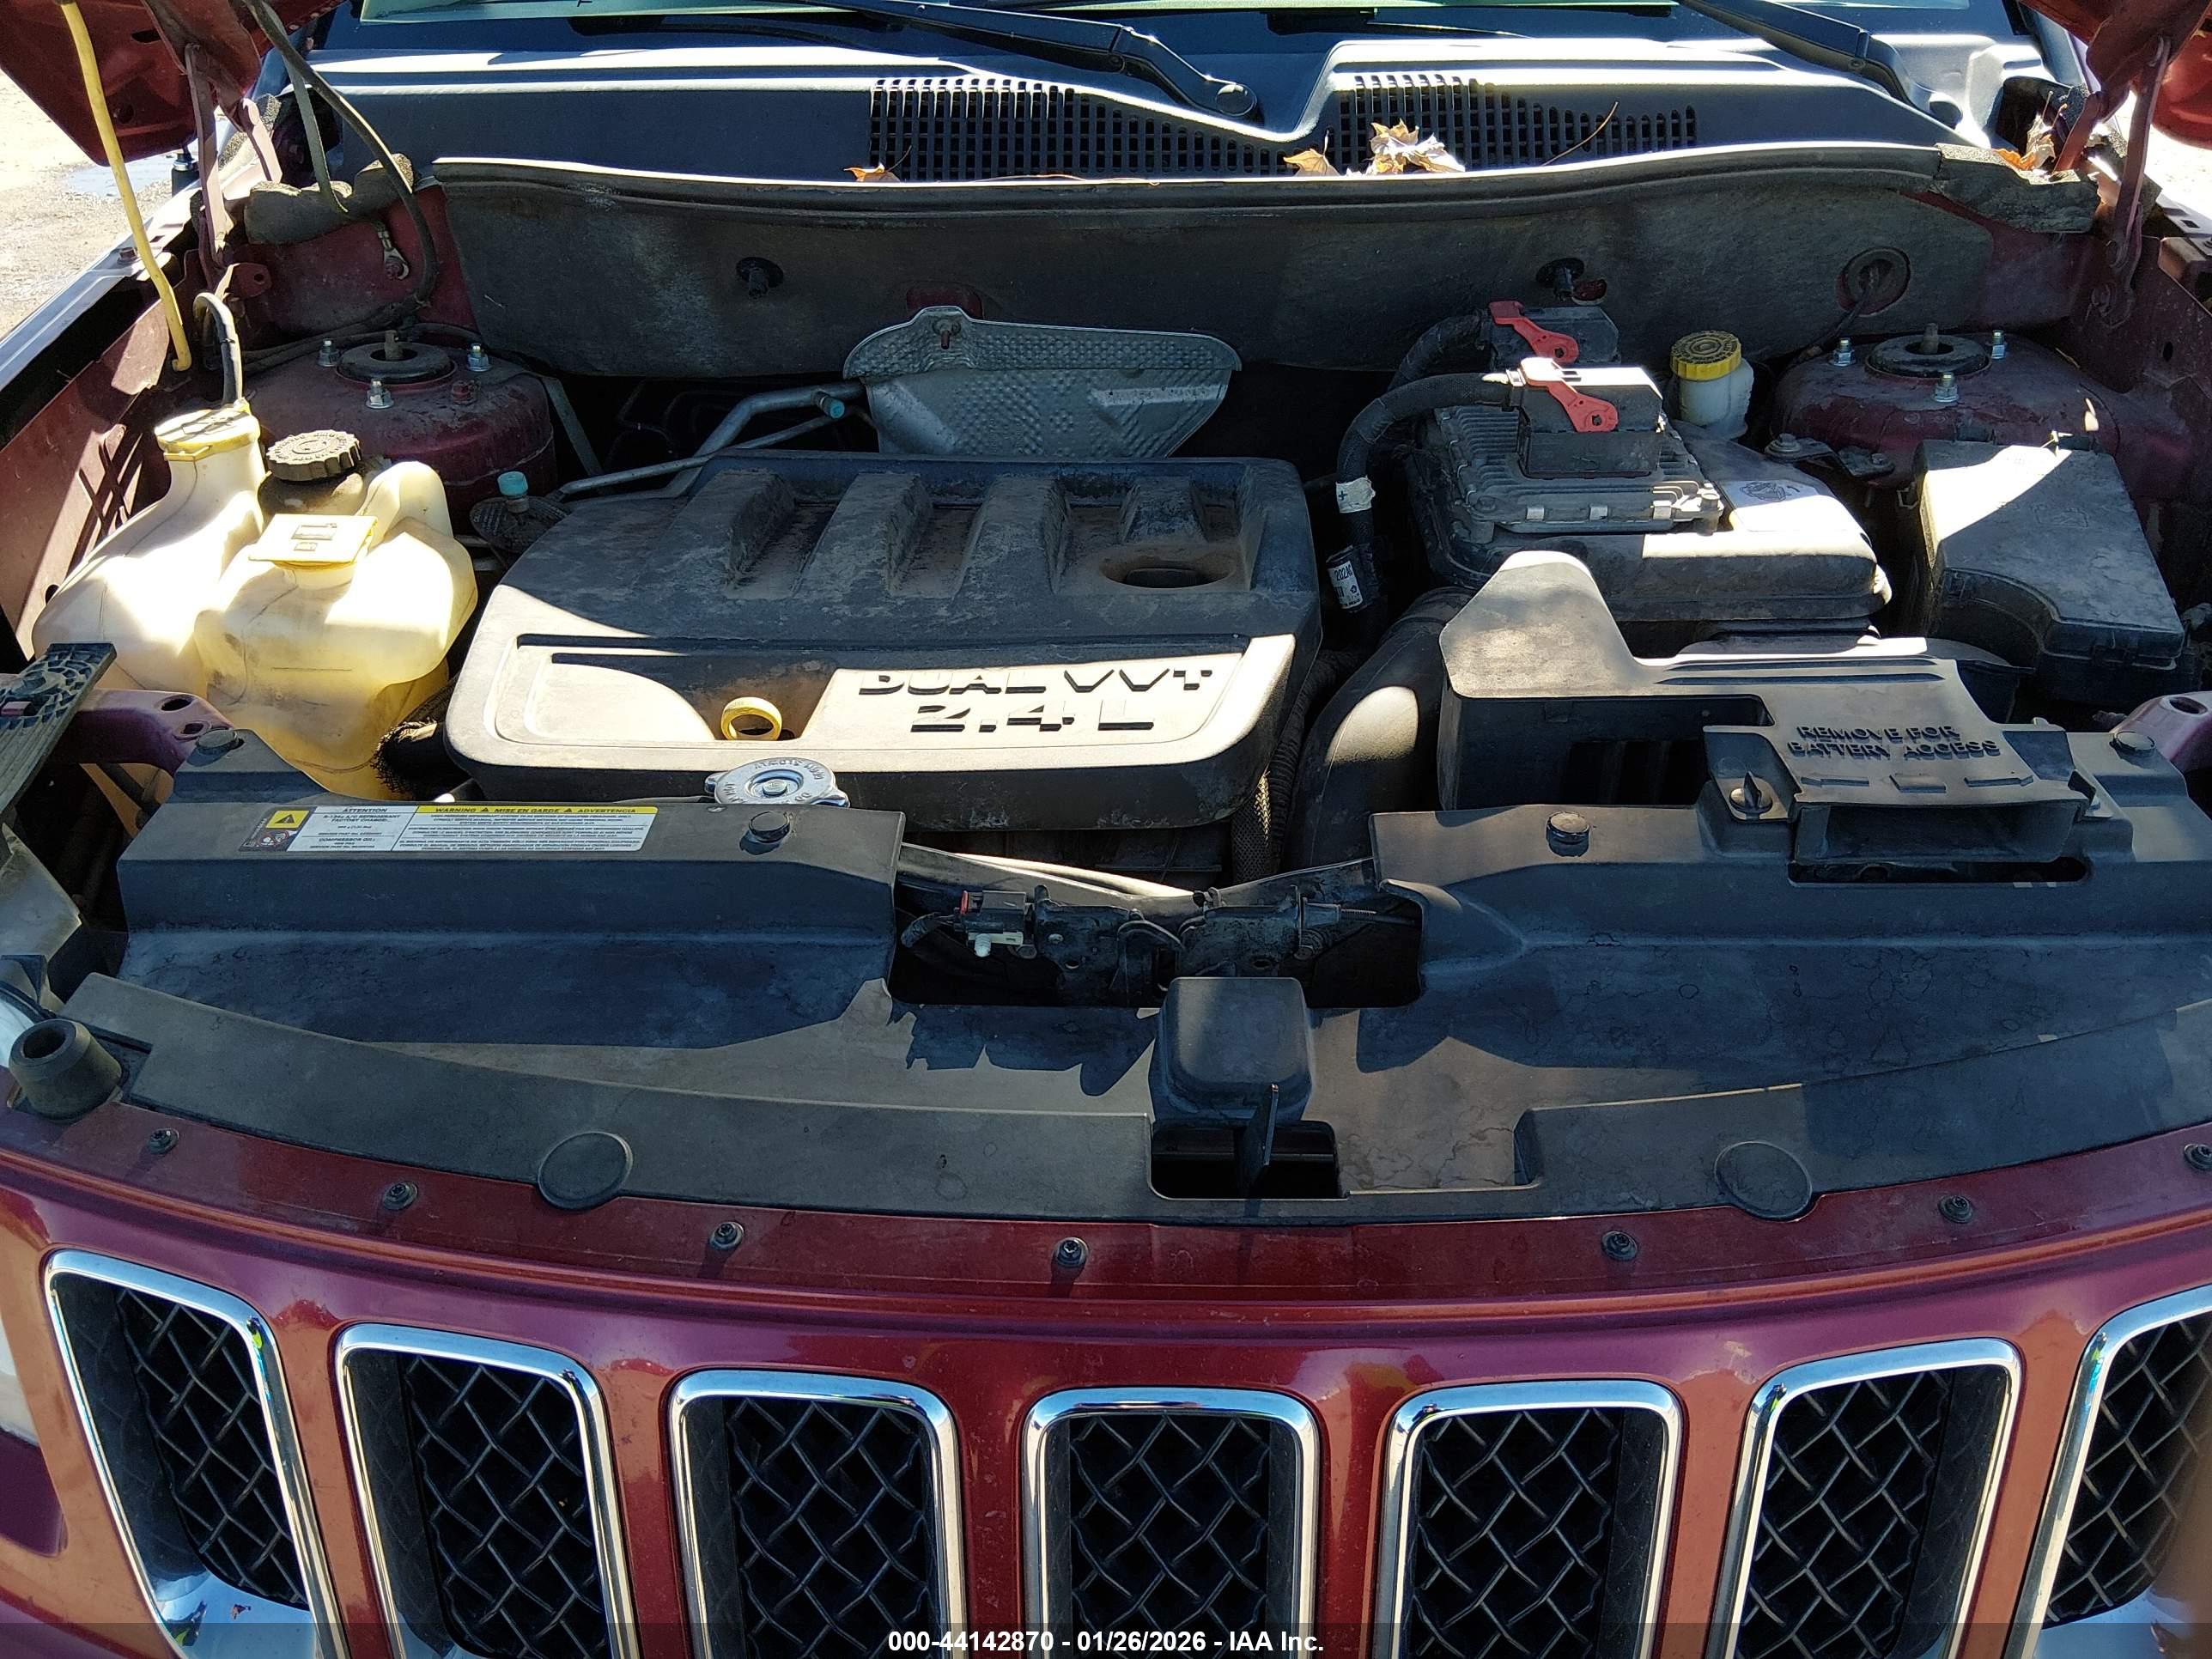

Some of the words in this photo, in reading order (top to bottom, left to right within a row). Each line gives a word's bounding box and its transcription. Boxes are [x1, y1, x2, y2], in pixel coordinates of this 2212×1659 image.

[859, 672, 1048, 696] DUAL
[1064, 669, 1213, 692] VVT
[910, 700, 1156, 733] 2.4L
[1796, 726, 1904, 744] REMOVE
[1905, 726, 1960, 743] FOR
[1787, 741, 1891, 760] BATTERY
[1903, 740, 2001, 760] ACCESS
